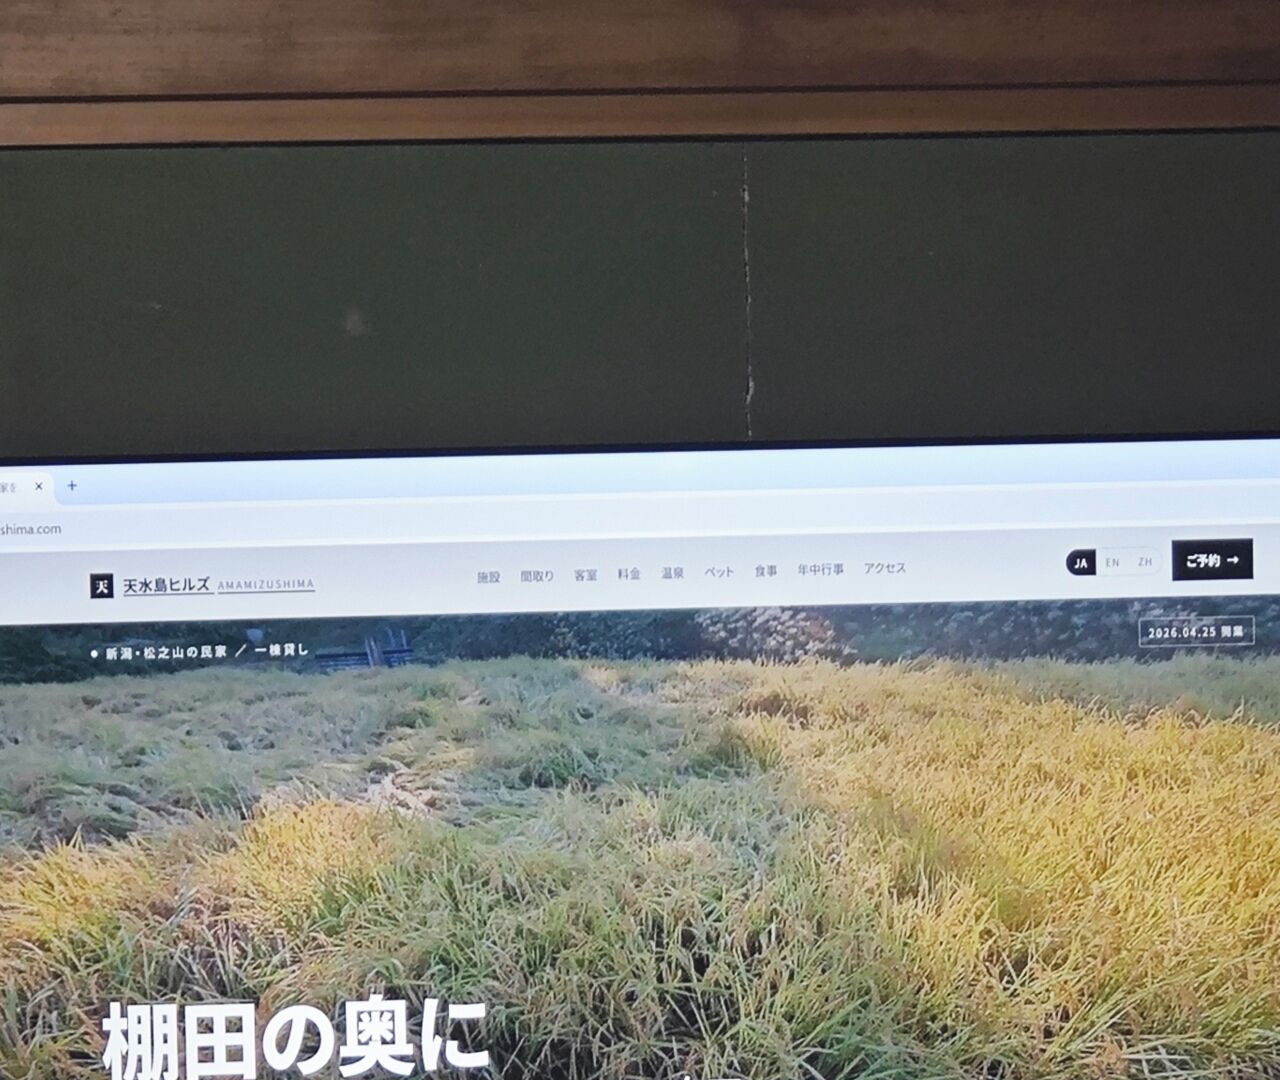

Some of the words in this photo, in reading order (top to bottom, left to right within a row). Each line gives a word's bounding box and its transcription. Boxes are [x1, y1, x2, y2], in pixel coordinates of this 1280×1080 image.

[863, 561, 907, 575] アクセス
[1074, 558, 1088, 569] JA
[1106, 557, 1120, 568] EN
[1138, 556, 1153, 567] ZH
[1186, 553, 1221, 569] ご予約
[520, 569, 554, 583] 間取り
[574, 568, 598, 582] 客室
[617, 567, 641, 581] 料金
[661, 566, 685, 580] 温泉
[704, 565, 734, 578] ペット
[755, 564, 777, 578] 食事
[797, 562, 844, 577] 年中行事
[477, 571, 501, 584] 施設
[95, 580, 109, 594] 天
[123, 576, 211, 593] 天水島ヒルズ
[217, 578, 315, 591] AMAMIZUSHIMA
[1148, 626, 1217, 639] 2026.04.25
